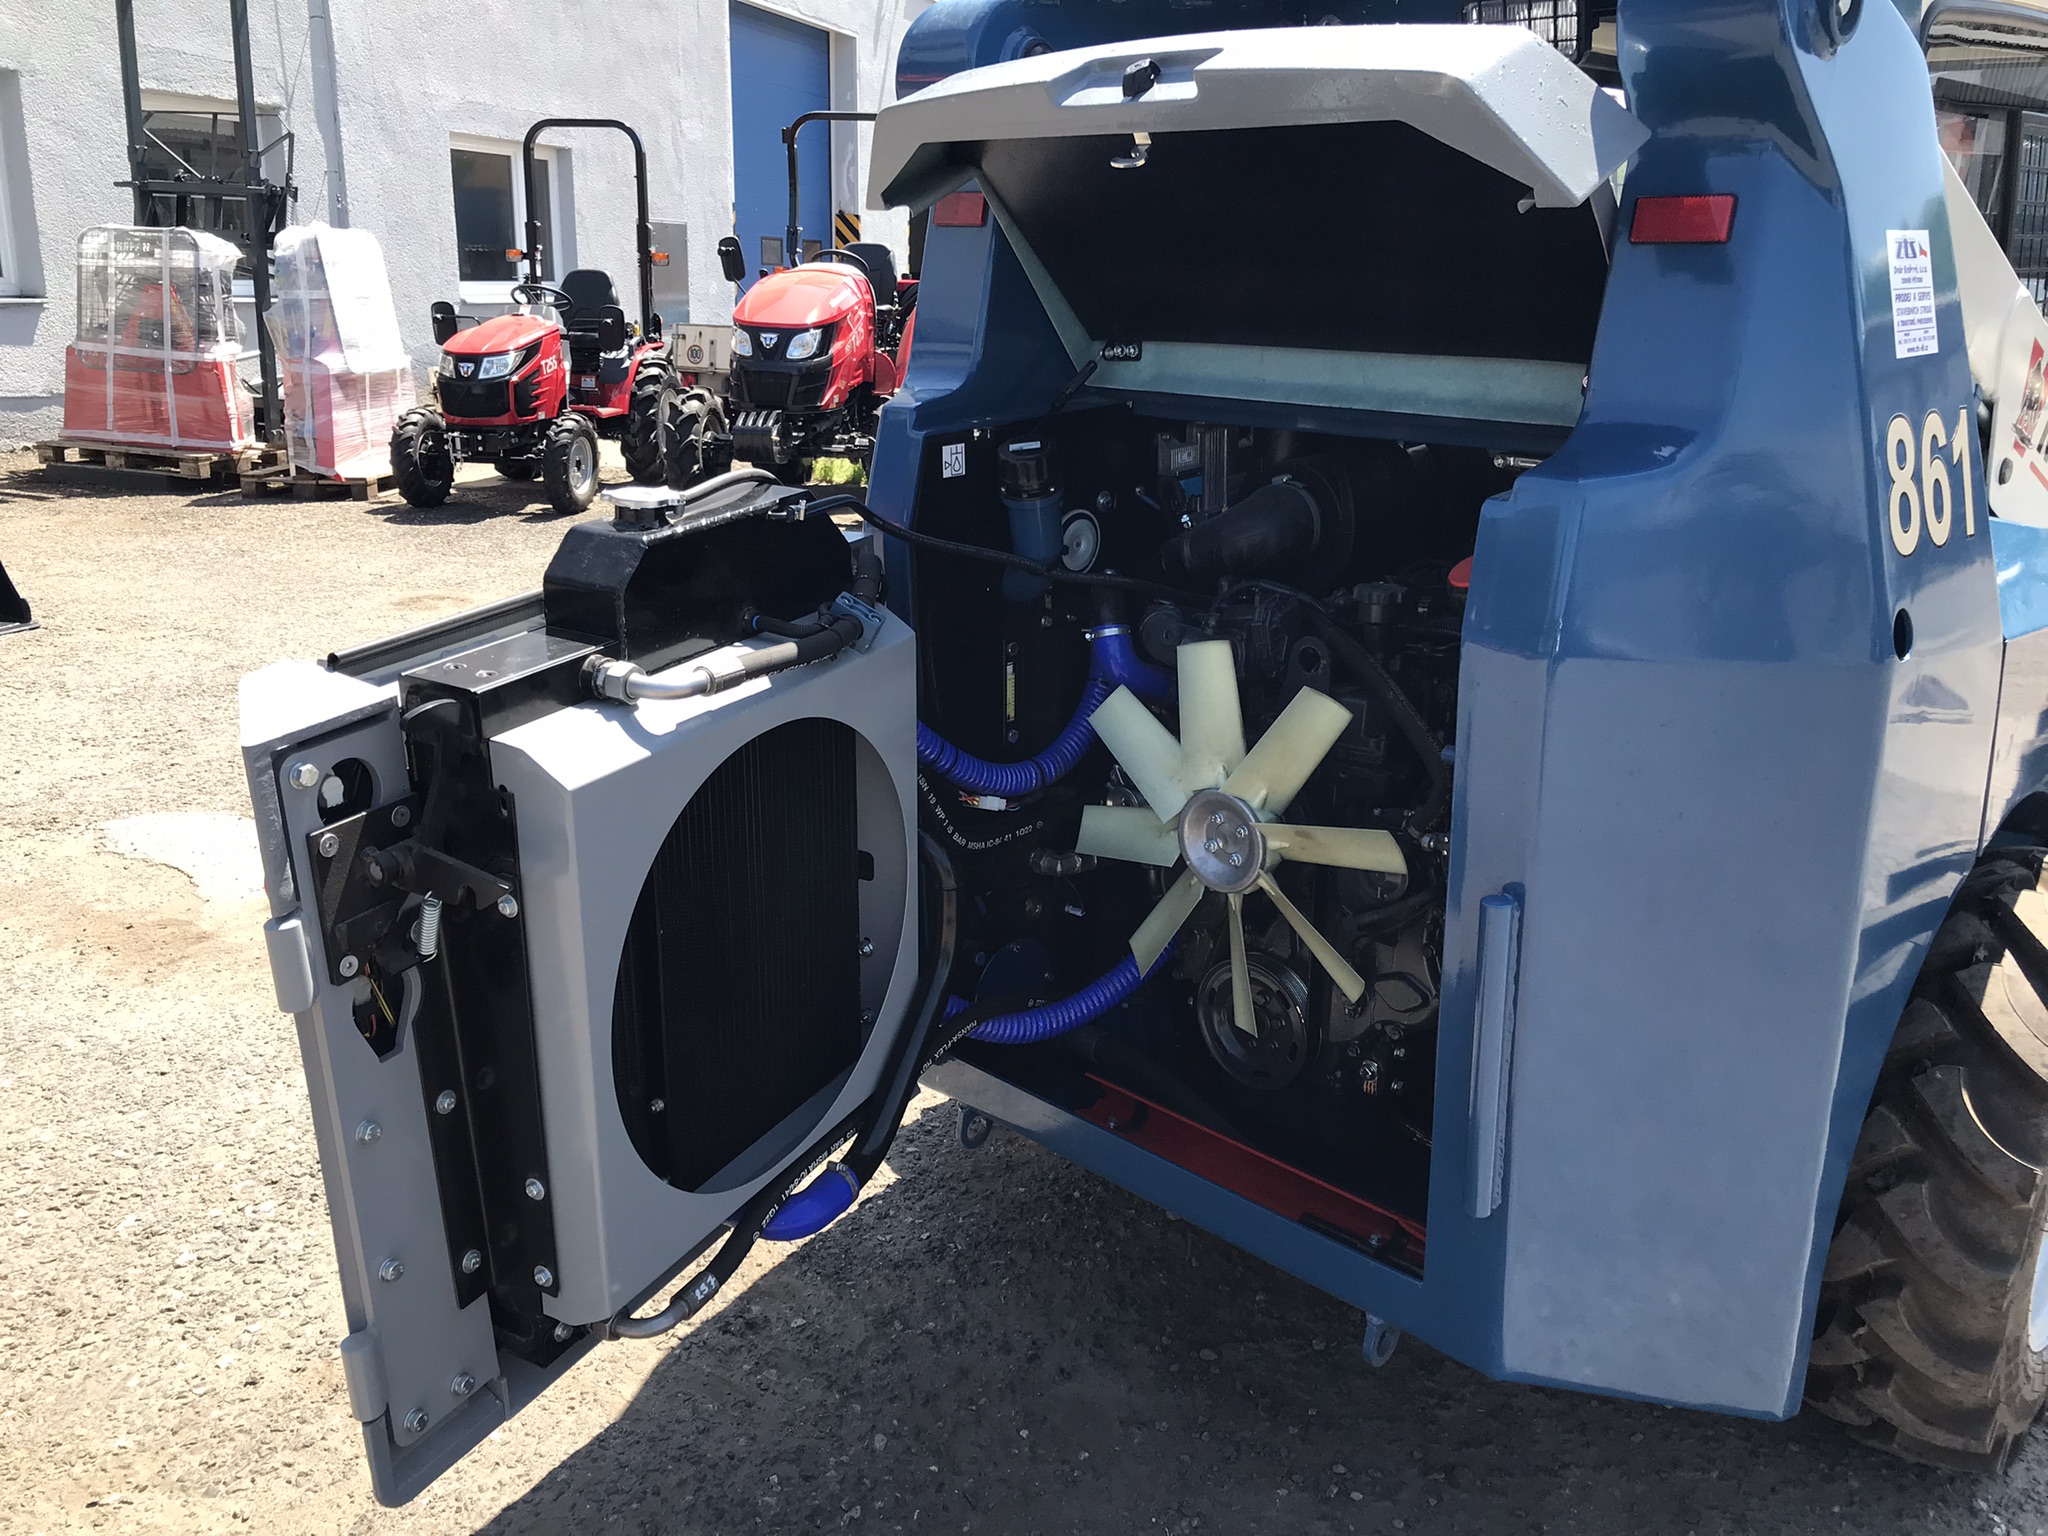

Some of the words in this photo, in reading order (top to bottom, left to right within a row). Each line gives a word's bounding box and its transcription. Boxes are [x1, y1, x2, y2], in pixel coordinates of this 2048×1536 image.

[1886, 404, 1976, 558] 861
[952, 832, 967, 847] BAR
[934, 1019, 978, 1060] HANSA-FLEX
